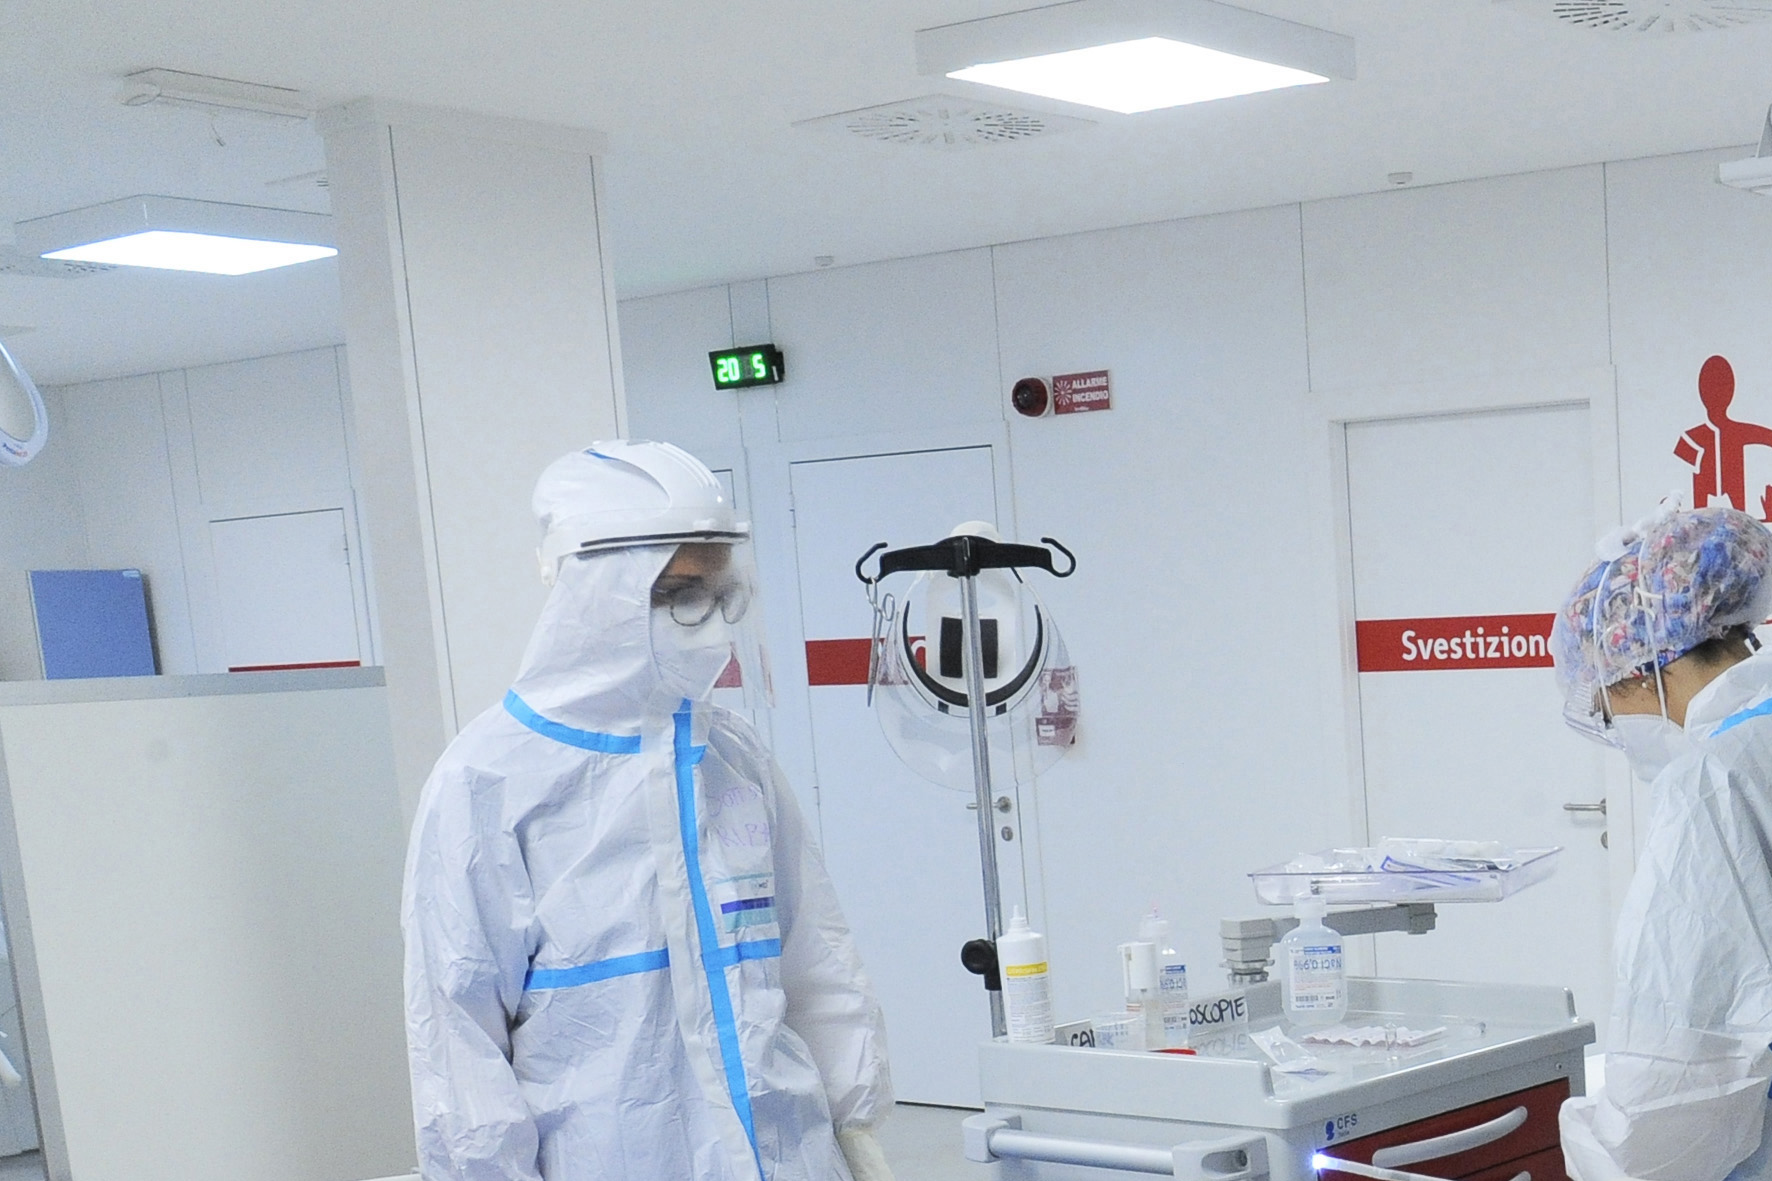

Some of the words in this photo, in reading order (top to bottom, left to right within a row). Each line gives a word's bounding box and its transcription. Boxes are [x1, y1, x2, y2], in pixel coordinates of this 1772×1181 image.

[1072, 376, 1108, 389] ALLARME
[1072, 390, 1108, 403] INCENDIO
[1337, 1113, 1358, 1130] CFS
